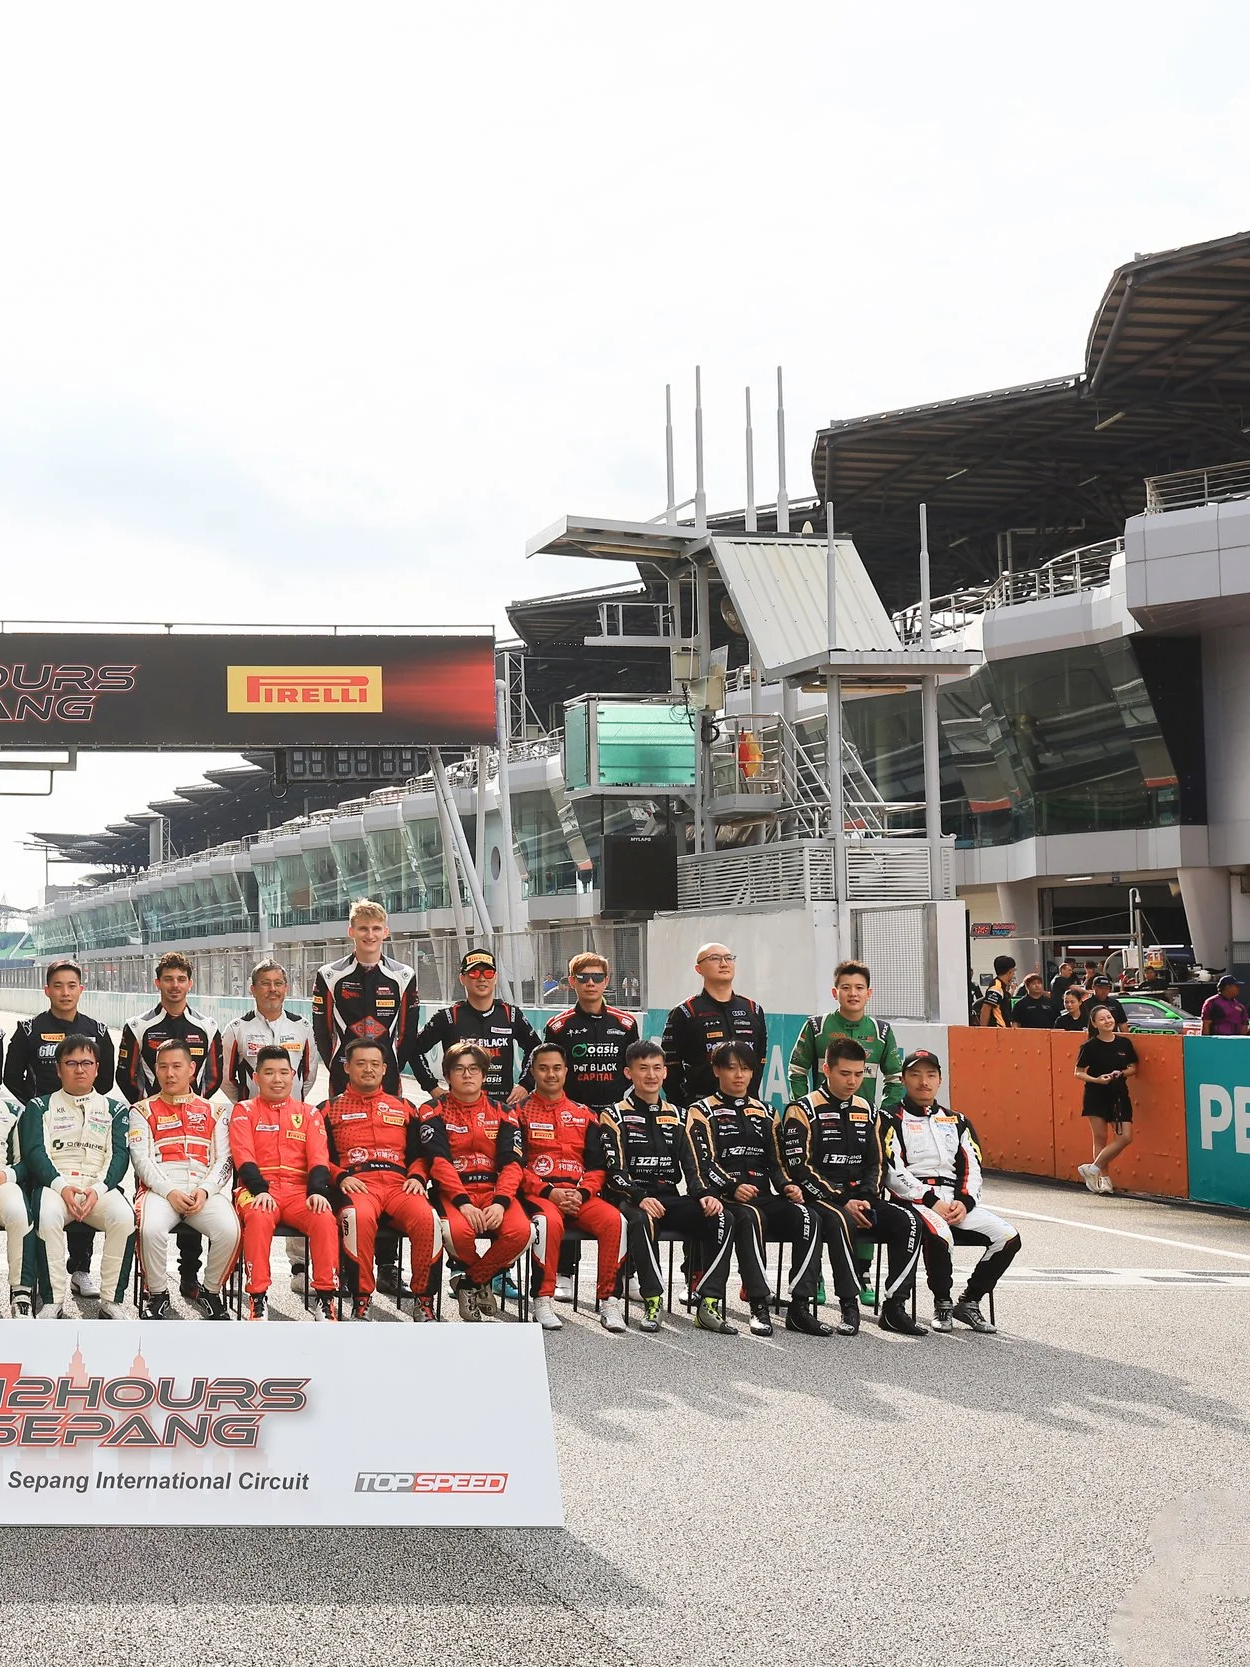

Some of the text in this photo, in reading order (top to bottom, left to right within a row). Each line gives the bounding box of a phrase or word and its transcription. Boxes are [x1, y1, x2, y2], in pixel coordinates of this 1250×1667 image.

[246, 675, 367, 704] PIRELLI
[587, 1043, 619, 1054] oasis
[590, 1063, 617, 1072] BLACK
[577, 1073, 614, 1081] CAPITAL
[8, 1472, 90, 1494] Sepang
[96, 1472, 232, 1490] International
[238, 1473, 309, 1491] Circuit
